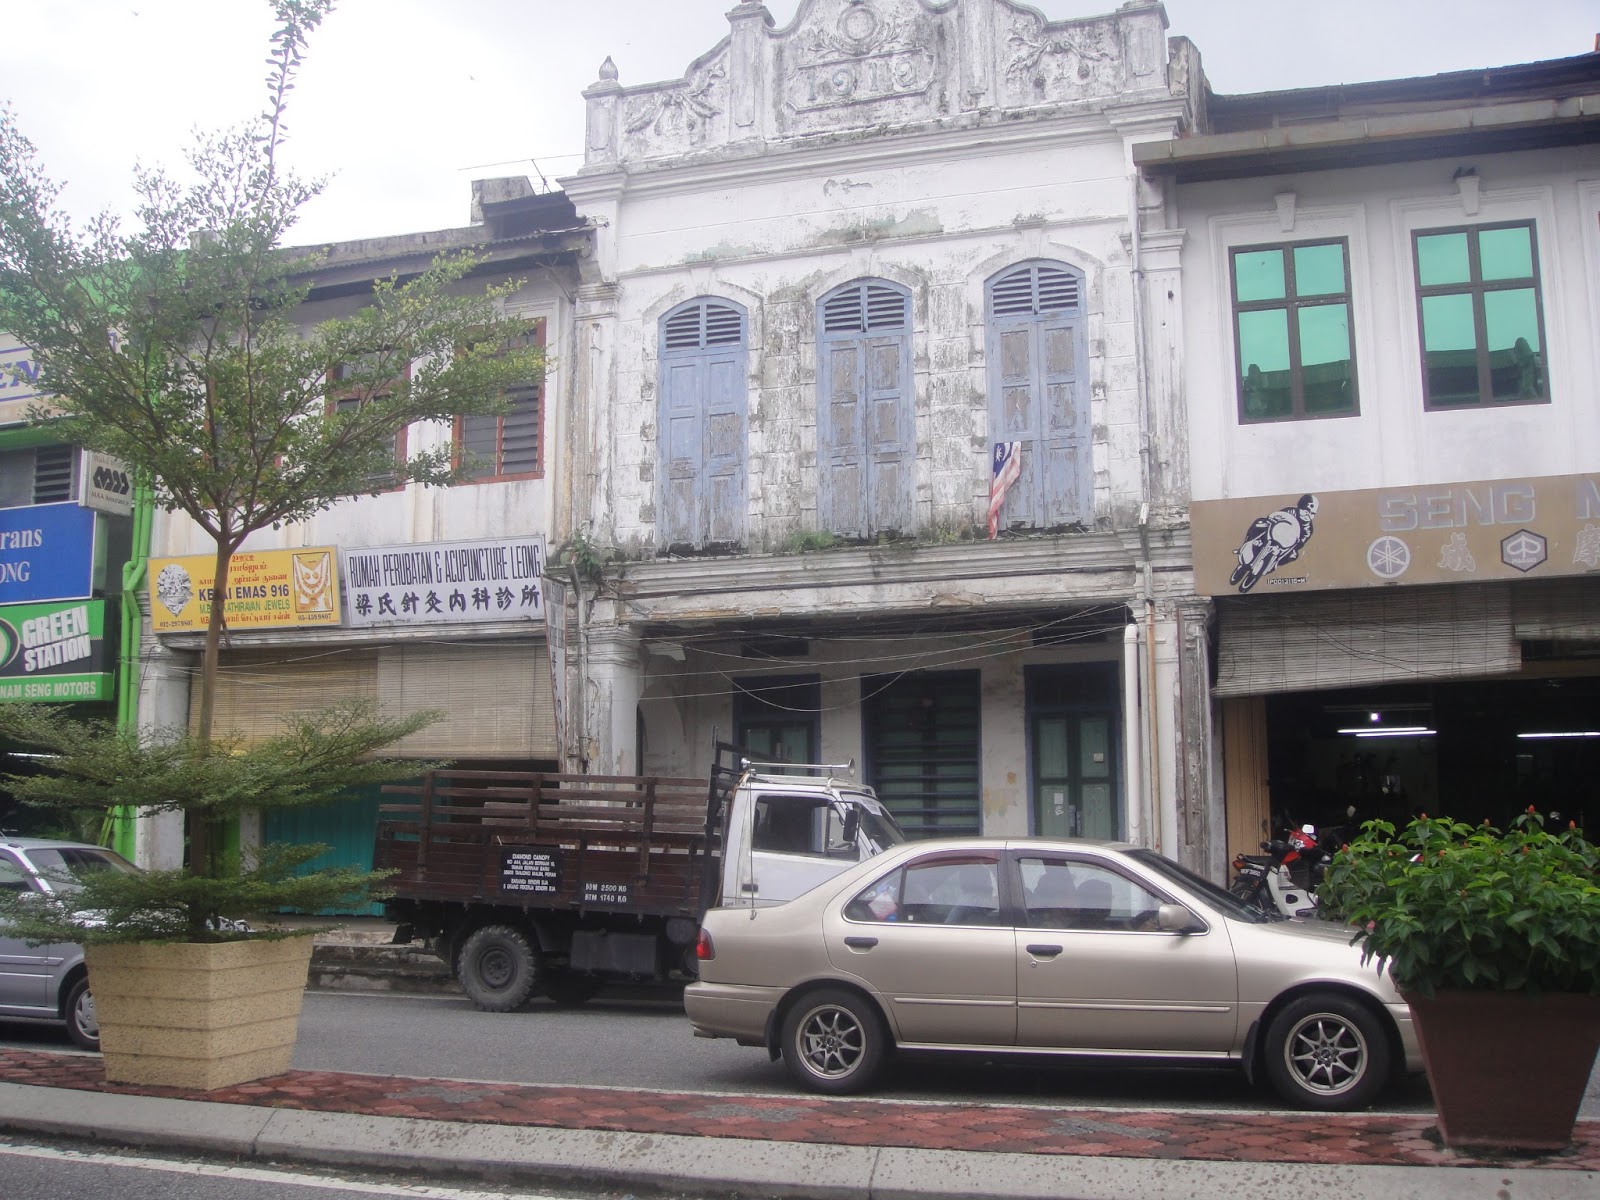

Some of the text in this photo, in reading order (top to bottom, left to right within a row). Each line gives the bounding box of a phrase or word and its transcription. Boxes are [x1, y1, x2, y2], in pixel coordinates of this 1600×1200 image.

[1378, 482, 1536, 532] SENG
[350, 555, 381, 588] RUMAH
[382, 551, 433, 586] PERUBATAN
[444, 546, 508, 582] ACUPUNCTURE
[510, 544, 541, 580] LEONG
[236, 585, 267, 599] EMAS
[271, 584, 289, 597] 916
[264, 599, 290, 611] JEWELS
[22, 605, 89, 649] GREEN
[24, 634, 92, 672] STATION
[25, 683, 51, 697] SENG
[54, 681, 97, 696] MOTORS
